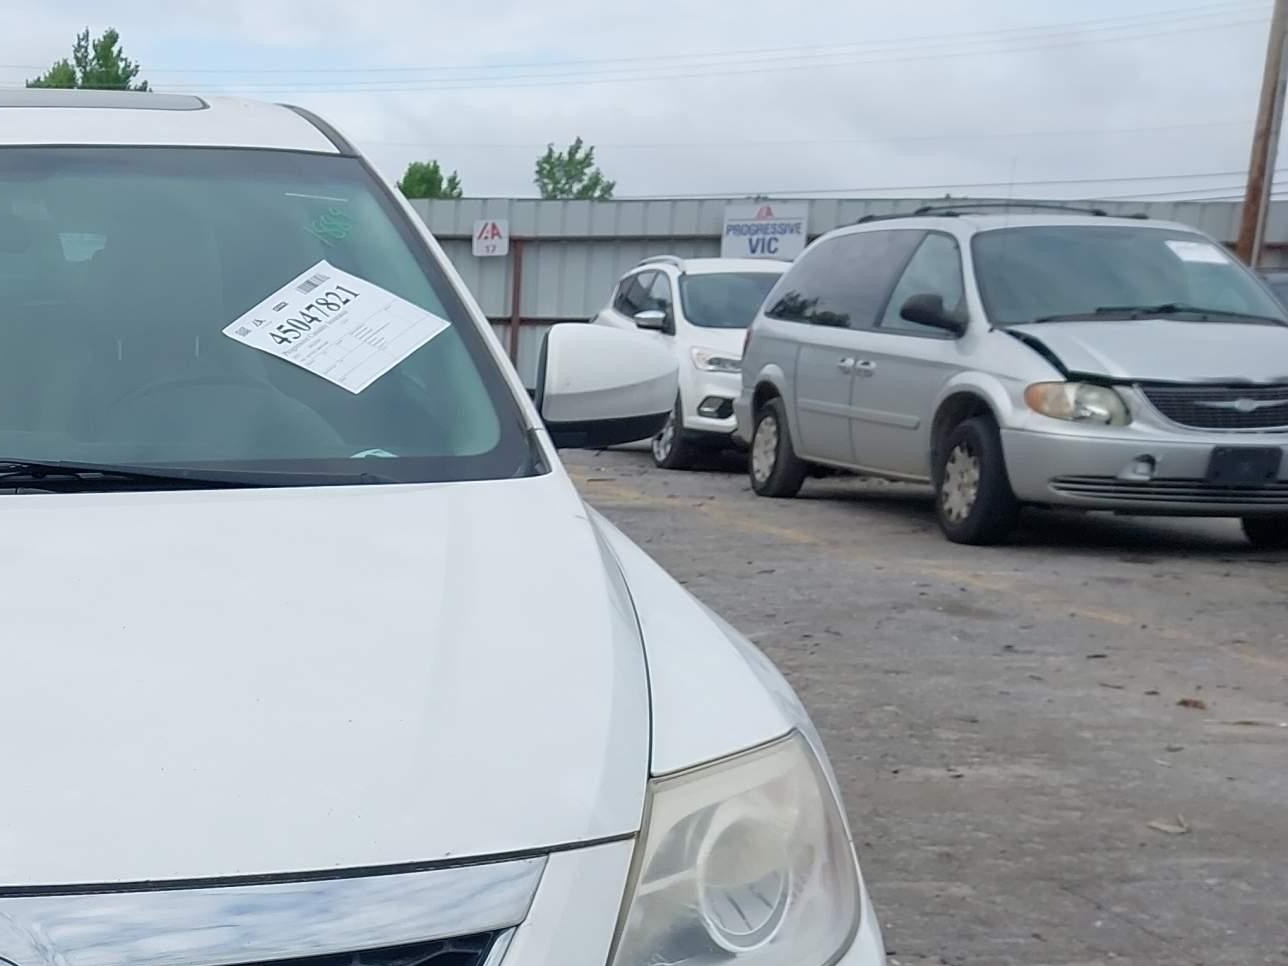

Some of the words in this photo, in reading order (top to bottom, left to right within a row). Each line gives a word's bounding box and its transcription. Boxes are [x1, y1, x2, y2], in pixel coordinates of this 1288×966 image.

[726, 222, 802, 236] PROGRESSIVE
[748, 237, 779, 255] VIC
[268, 285, 361, 346] 45047821
